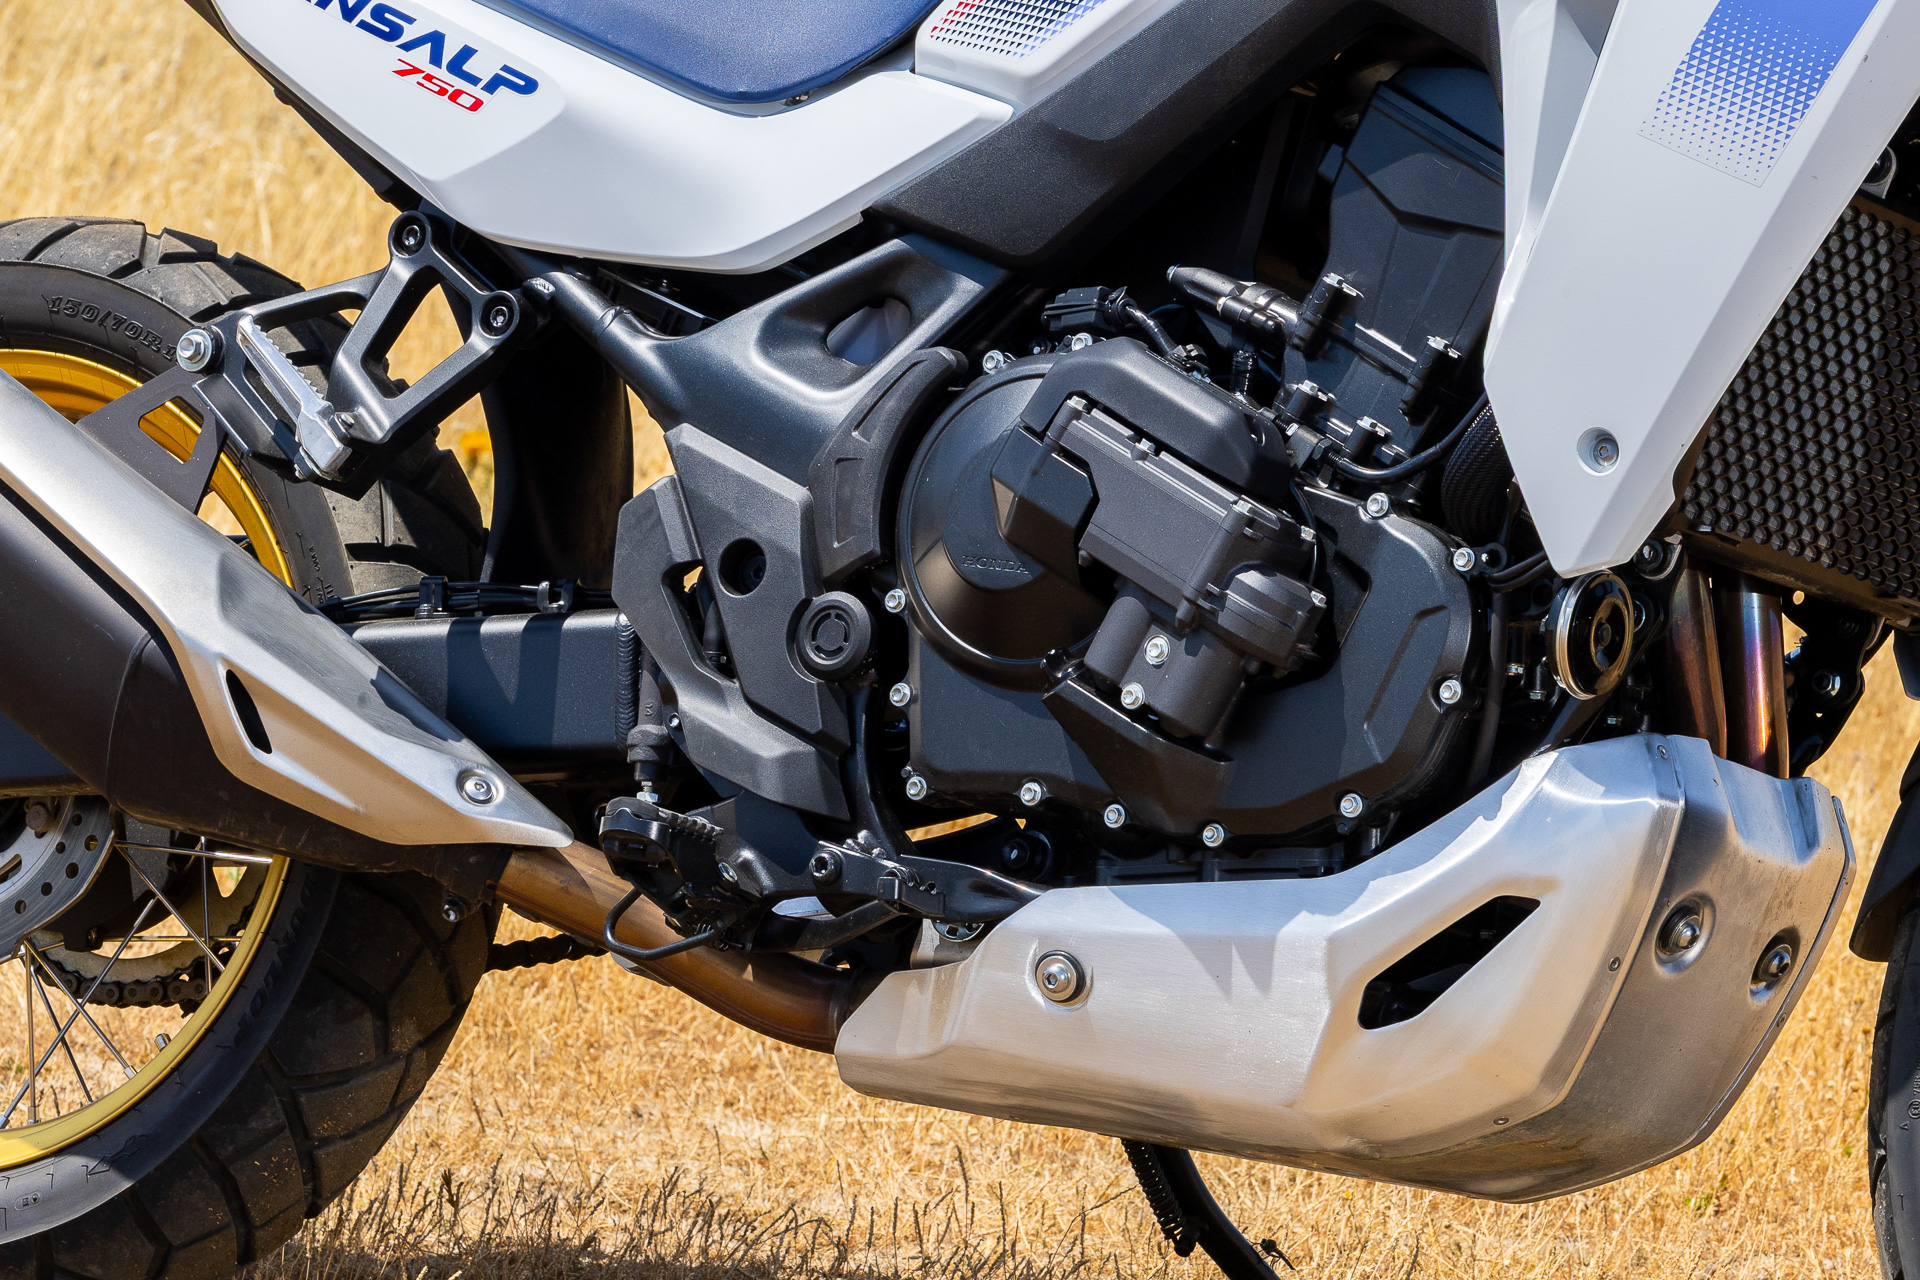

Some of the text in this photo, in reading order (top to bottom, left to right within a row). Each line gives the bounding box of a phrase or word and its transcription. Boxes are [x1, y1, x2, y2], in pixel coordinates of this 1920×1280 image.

[305, 0, 539, 95] NSALP
[392, 58, 484, 112] 750
[49, 296, 180, 363] 150/70R1
[961, 555, 1029, 574] HONDA
